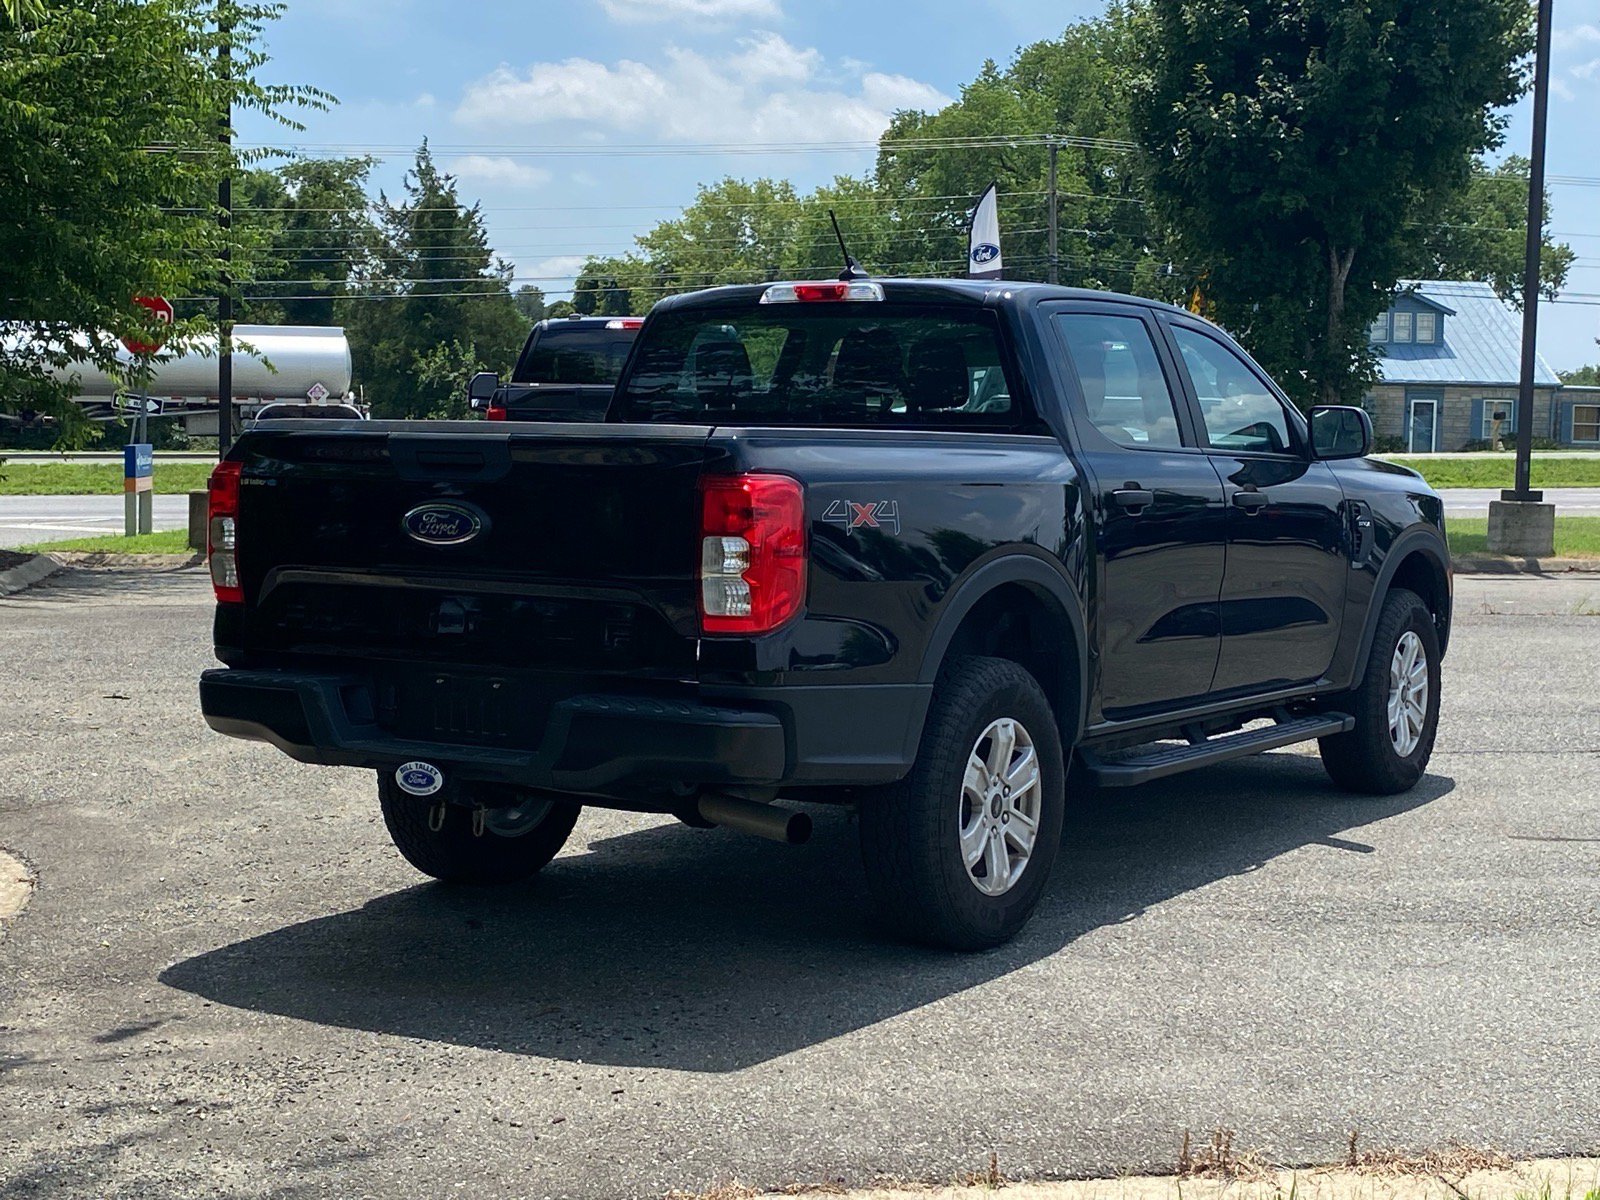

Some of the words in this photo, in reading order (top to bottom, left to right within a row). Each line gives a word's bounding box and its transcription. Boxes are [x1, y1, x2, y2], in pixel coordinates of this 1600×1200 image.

[976, 246, 992, 262] Ford
[419, 512, 460, 535] Ford
[408, 772, 428, 785] Ford
